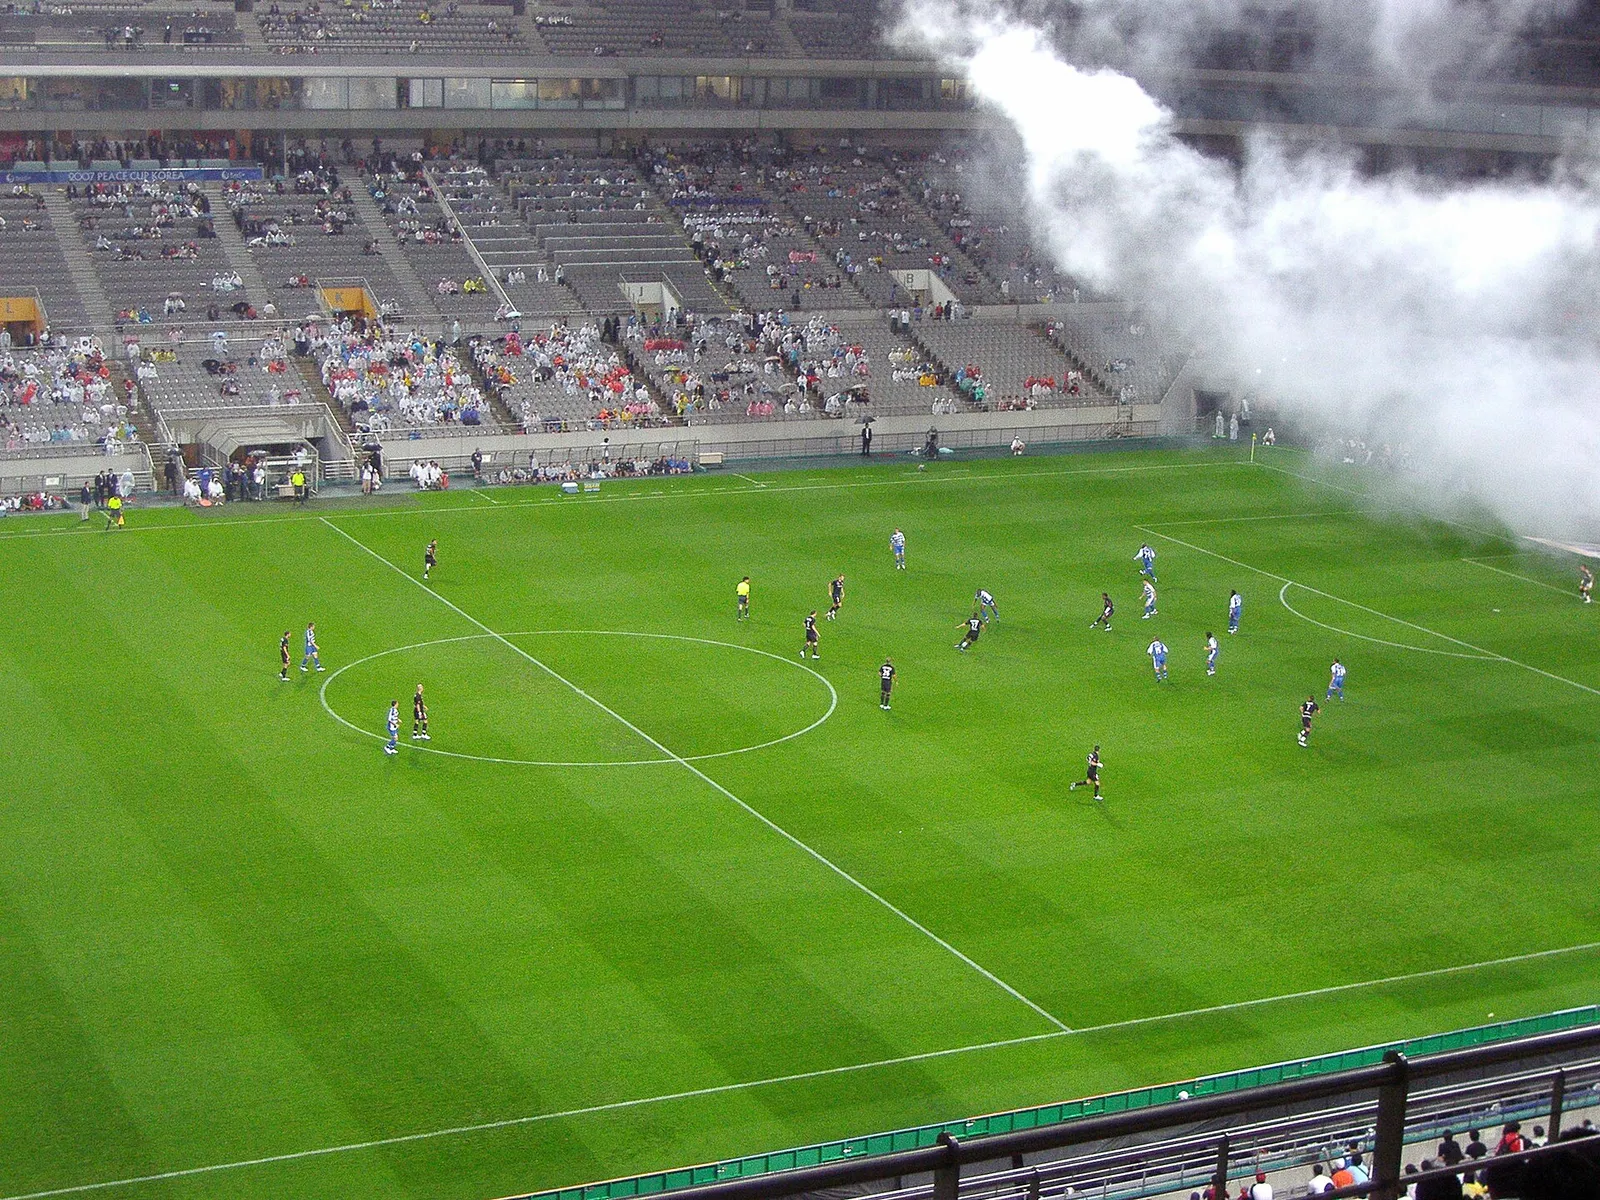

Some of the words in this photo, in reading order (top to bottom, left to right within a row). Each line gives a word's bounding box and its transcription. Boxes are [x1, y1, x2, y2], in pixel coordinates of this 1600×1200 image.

[69, 172, 95, 182] 2007
[97, 171, 128, 182] PEACE
[130, 172, 150, 182] CUP
[152, 171, 185, 182] KOREA
[906, 273, 914, 284] B
[639, 287, 643, 297] J
